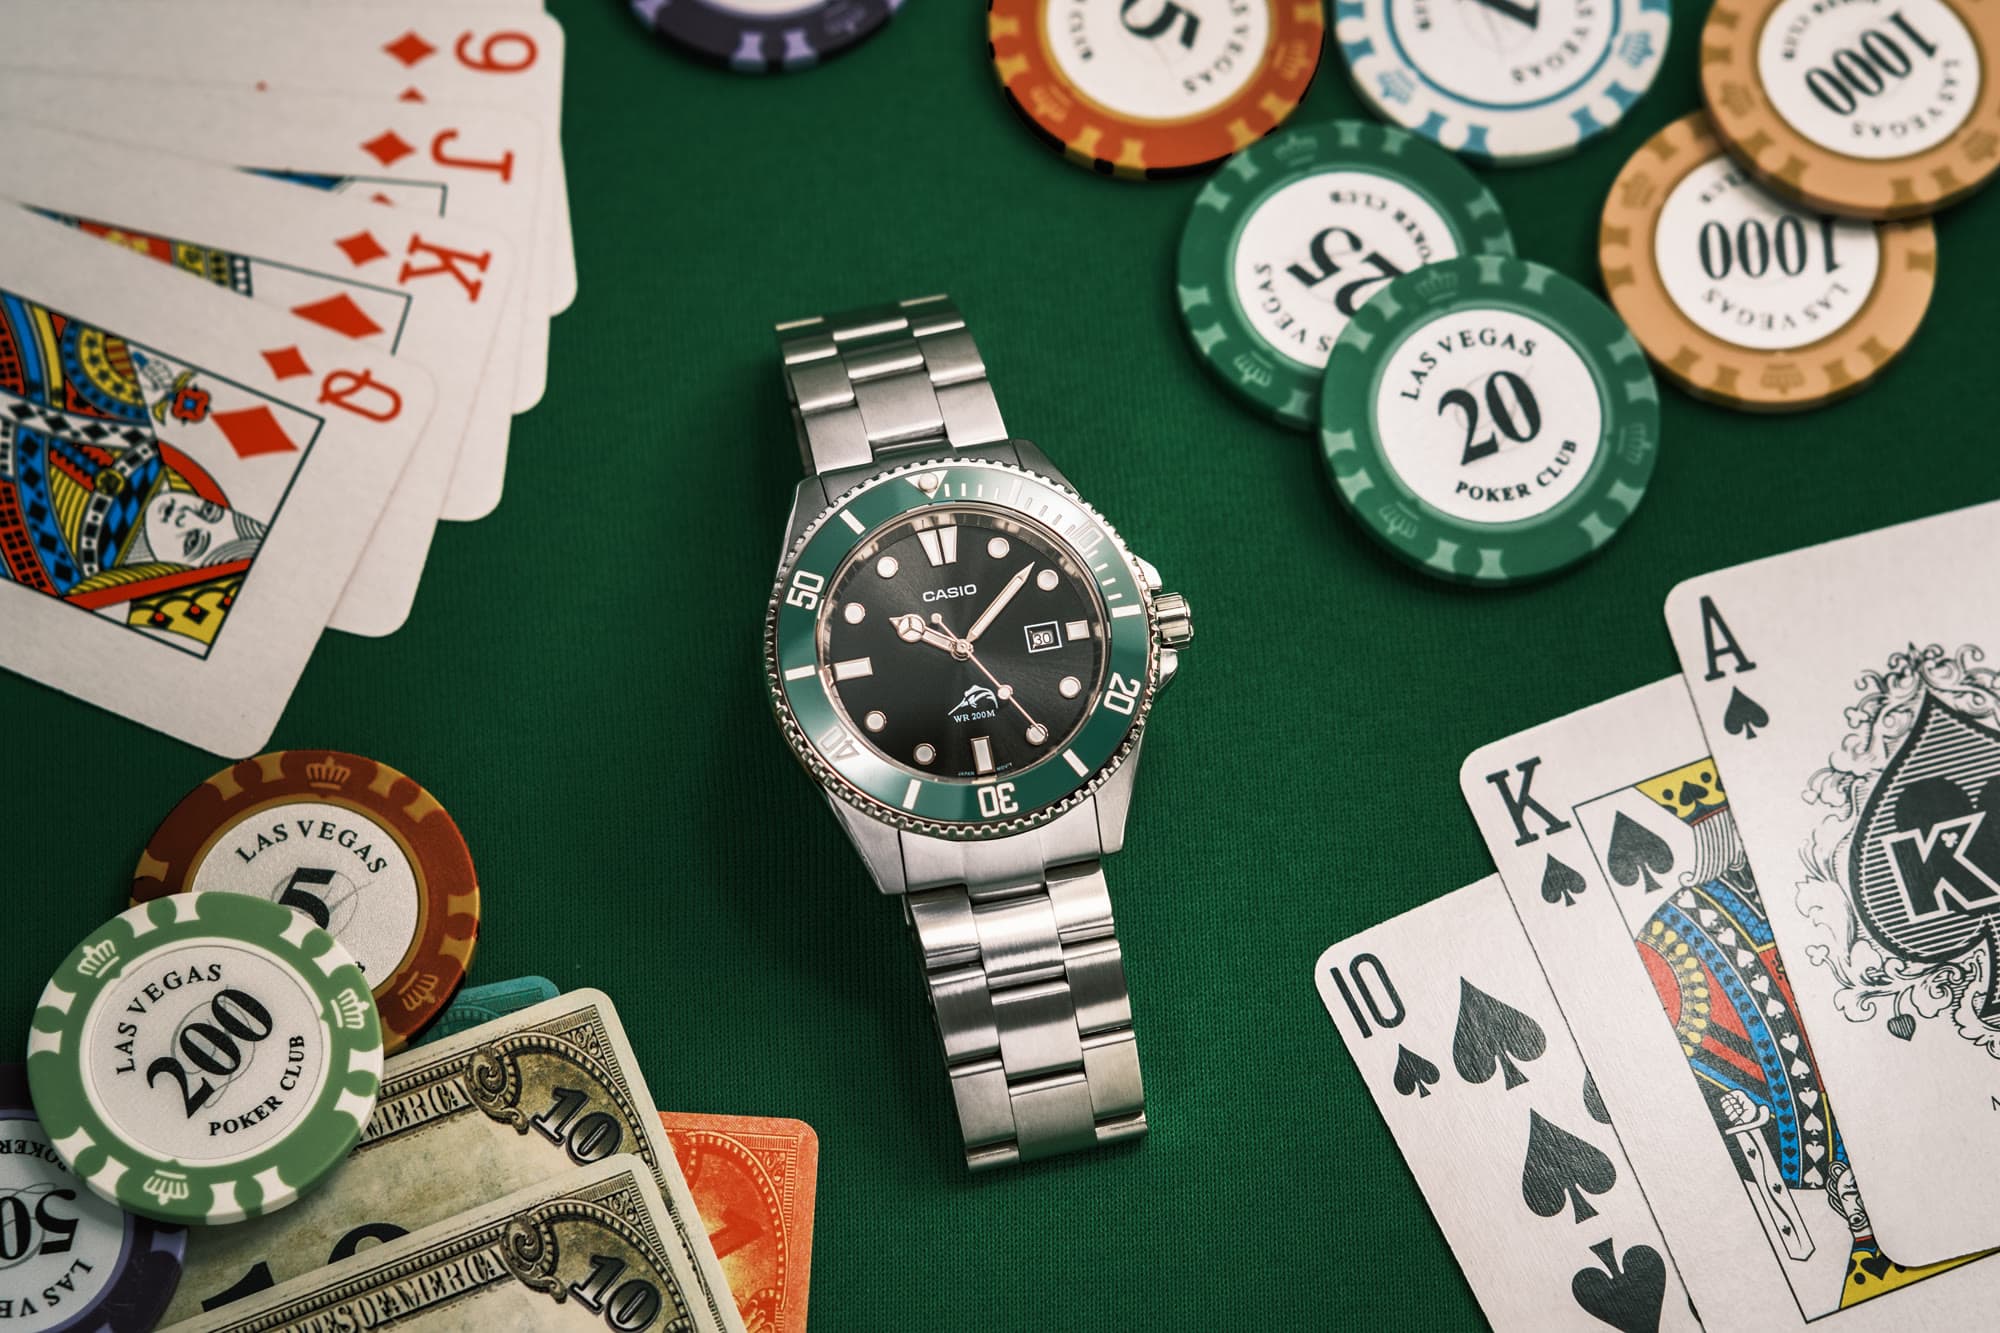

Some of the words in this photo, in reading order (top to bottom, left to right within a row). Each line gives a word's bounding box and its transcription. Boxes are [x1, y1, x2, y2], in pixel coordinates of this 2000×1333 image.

[455, 32, 538, 74] 9
[1804, 10, 1937, 116] 1000
[431, 129, 514, 183] J
[398, 234, 491, 303] K
[1393, 209, 1432, 265] OKER
[1698, 214, 1842, 281] 1000
[1285, 226, 1404, 318] 25
[318, 369, 402, 422] Q
[1400, 350, 1437, 401] LAS
[1437, 327, 1537, 358] VEGAS
[1437, 370, 1542, 467] 20
[1455, 481, 1532, 502] POKER
[1536, 440, 1577, 487] CLUB
[785, 570, 825, 612] 50
[922, 583, 977, 603] CASIO
[1699, 595, 1756, 682] A
[953, 713, 970, 724] WR
[972, 709, 996, 721] 200M
[1103, 671, 1142, 717] 20
[817, 724, 860, 762] 40
[977, 781, 1019, 818] 30
[1486, 755, 1572, 848] K
[235, 824, 289, 864] LAS
[297, 819, 388, 874] VEGAS
[113, 1021, 138, 1075] LAS
[126, 963, 222, 1015] VEGAS
[1329, 952, 1406, 1040] 10
[146, 988, 273, 1119] 200
[209, 1095, 284, 1136] POKER
[279, 1035, 305, 1091] CLUB
[531, 1086, 623, 1166] 10
[0, 1189, 79, 1260] 50
[42, 1258, 93, 1307] LAS
[571, 1254, 663, 1332] 10
